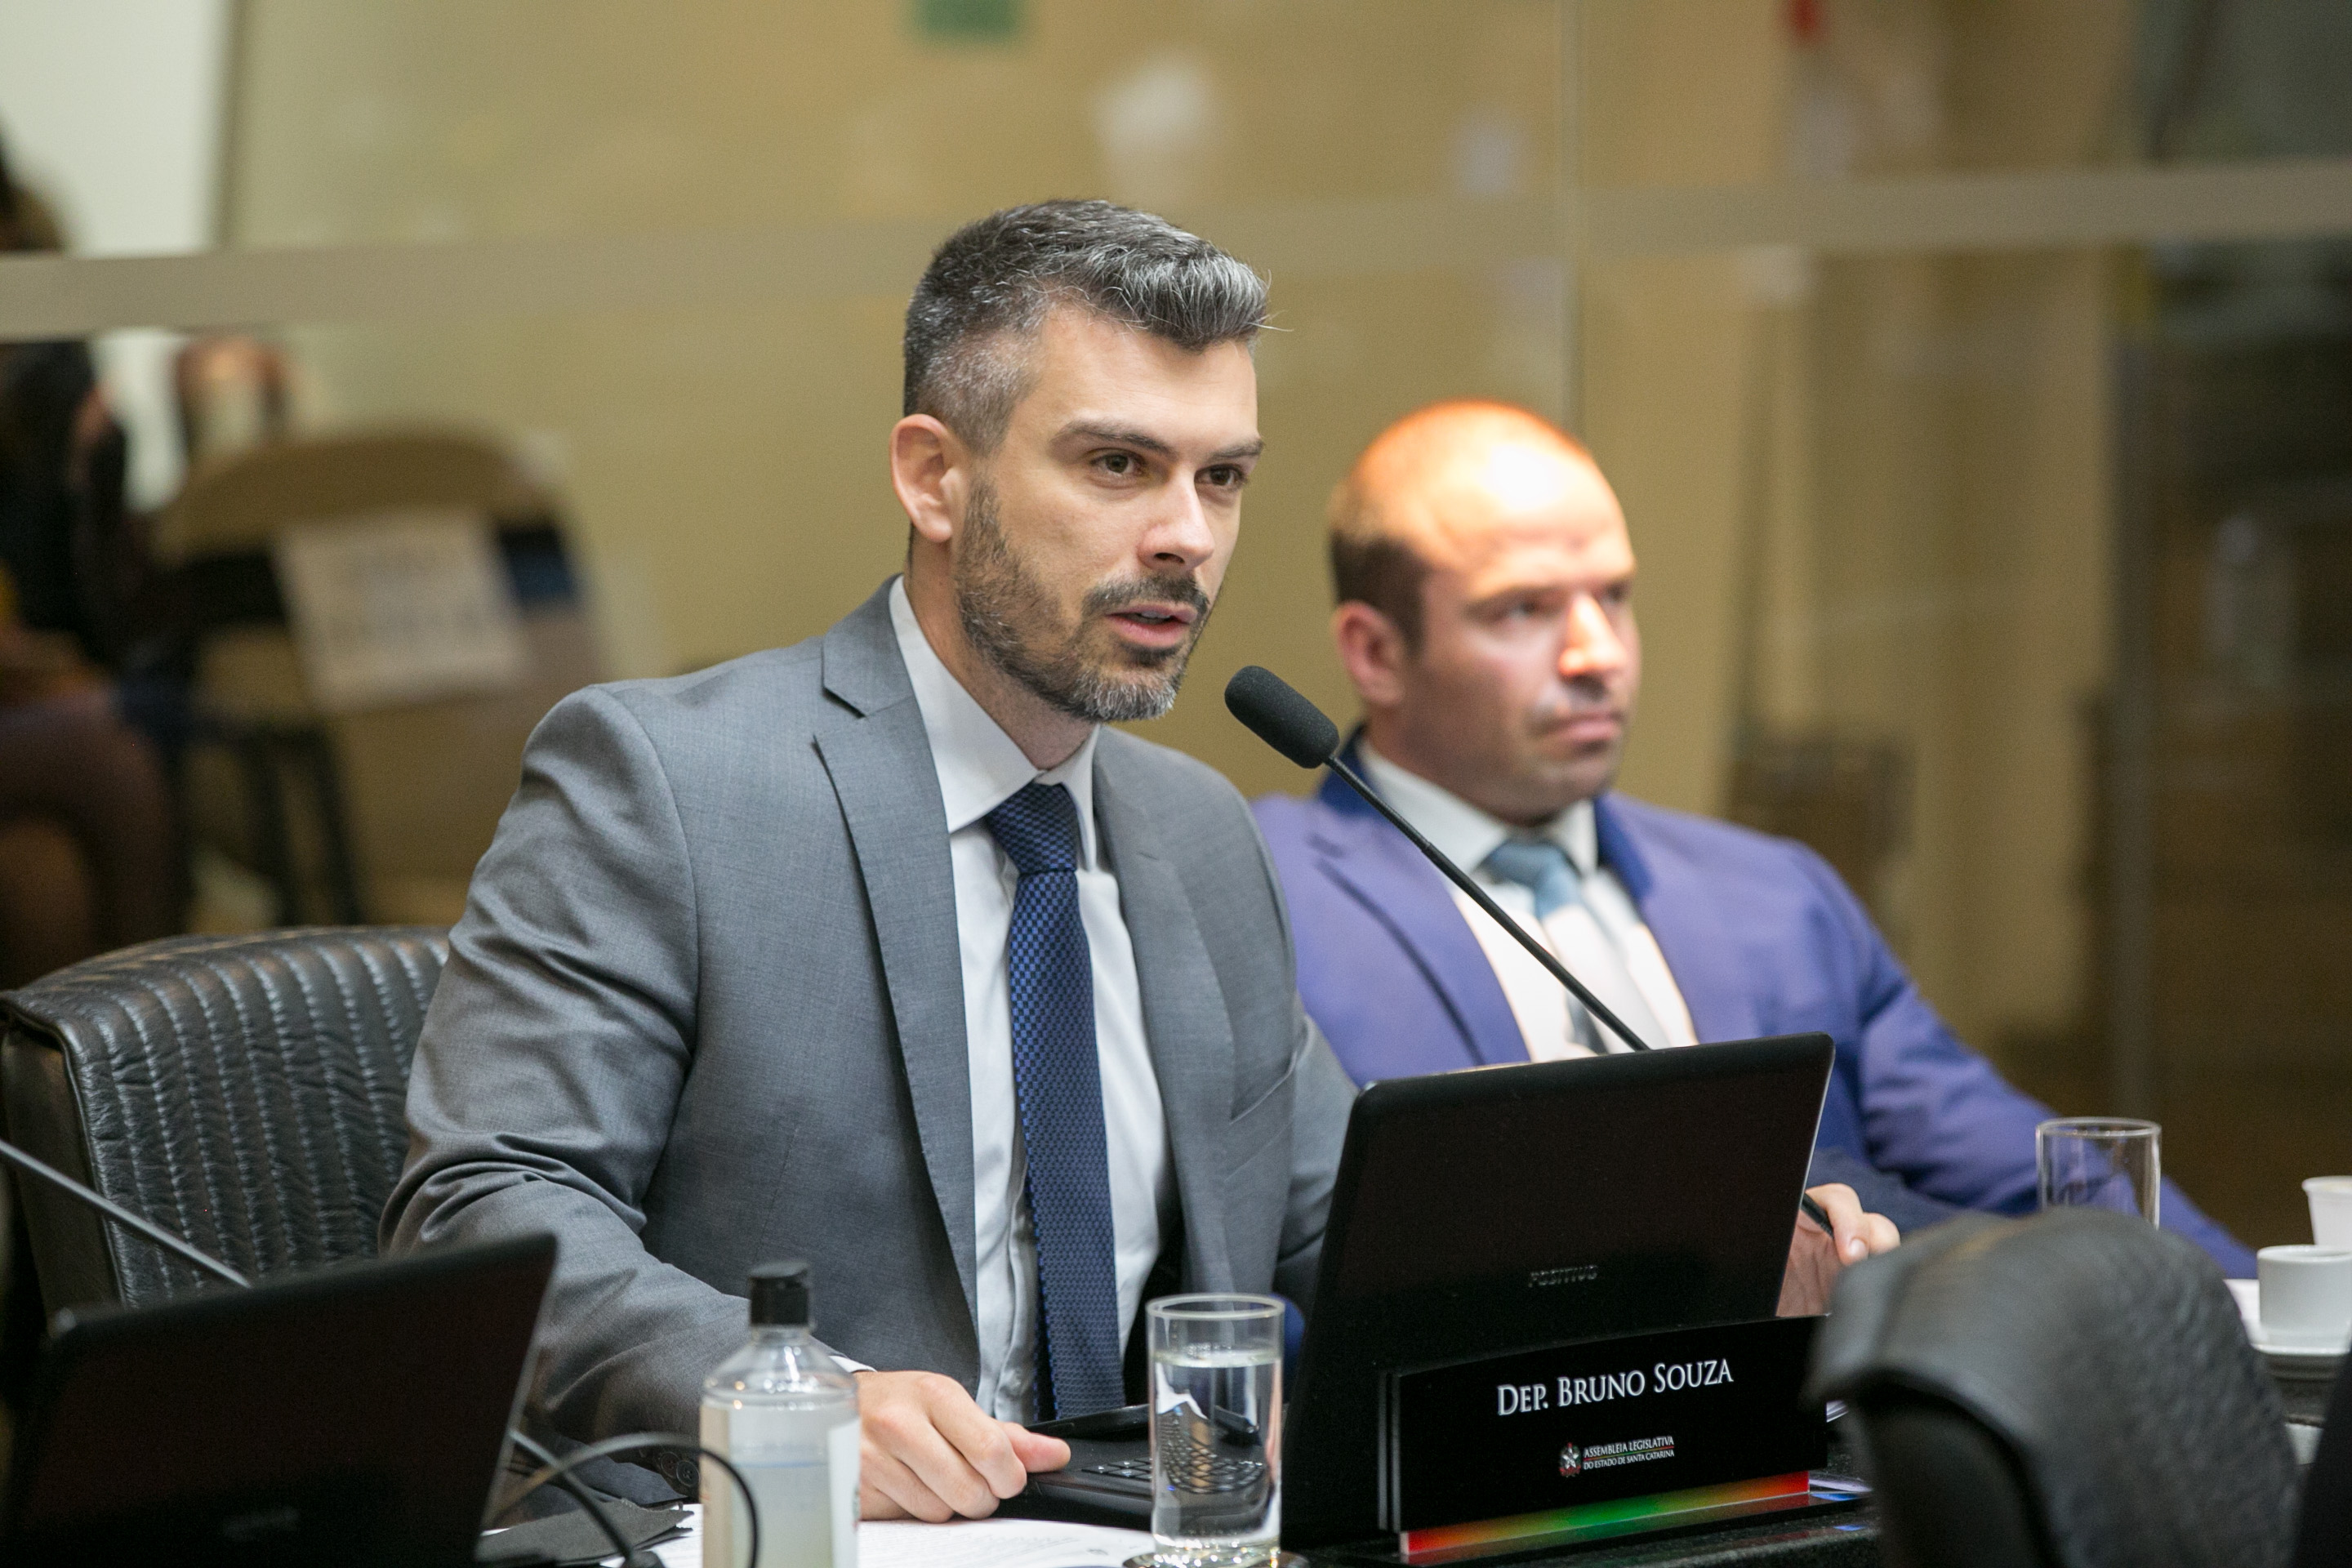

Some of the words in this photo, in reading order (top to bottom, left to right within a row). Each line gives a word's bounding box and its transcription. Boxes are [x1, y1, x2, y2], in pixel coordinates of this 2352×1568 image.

[1584, 1443, 1628, 1458] ASSEMBLEIA
[1628, 1436, 1674, 1451] LEGISLATIVA
[1584, 1461, 1593, 1470] DO
[1595, 1458, 1617, 1468] ESTADO
[1618, 1456, 1626, 1464] DE
[1627, 1454, 1646, 1463] SANTA
[1646, 1450, 1674, 1460] CATARINA
